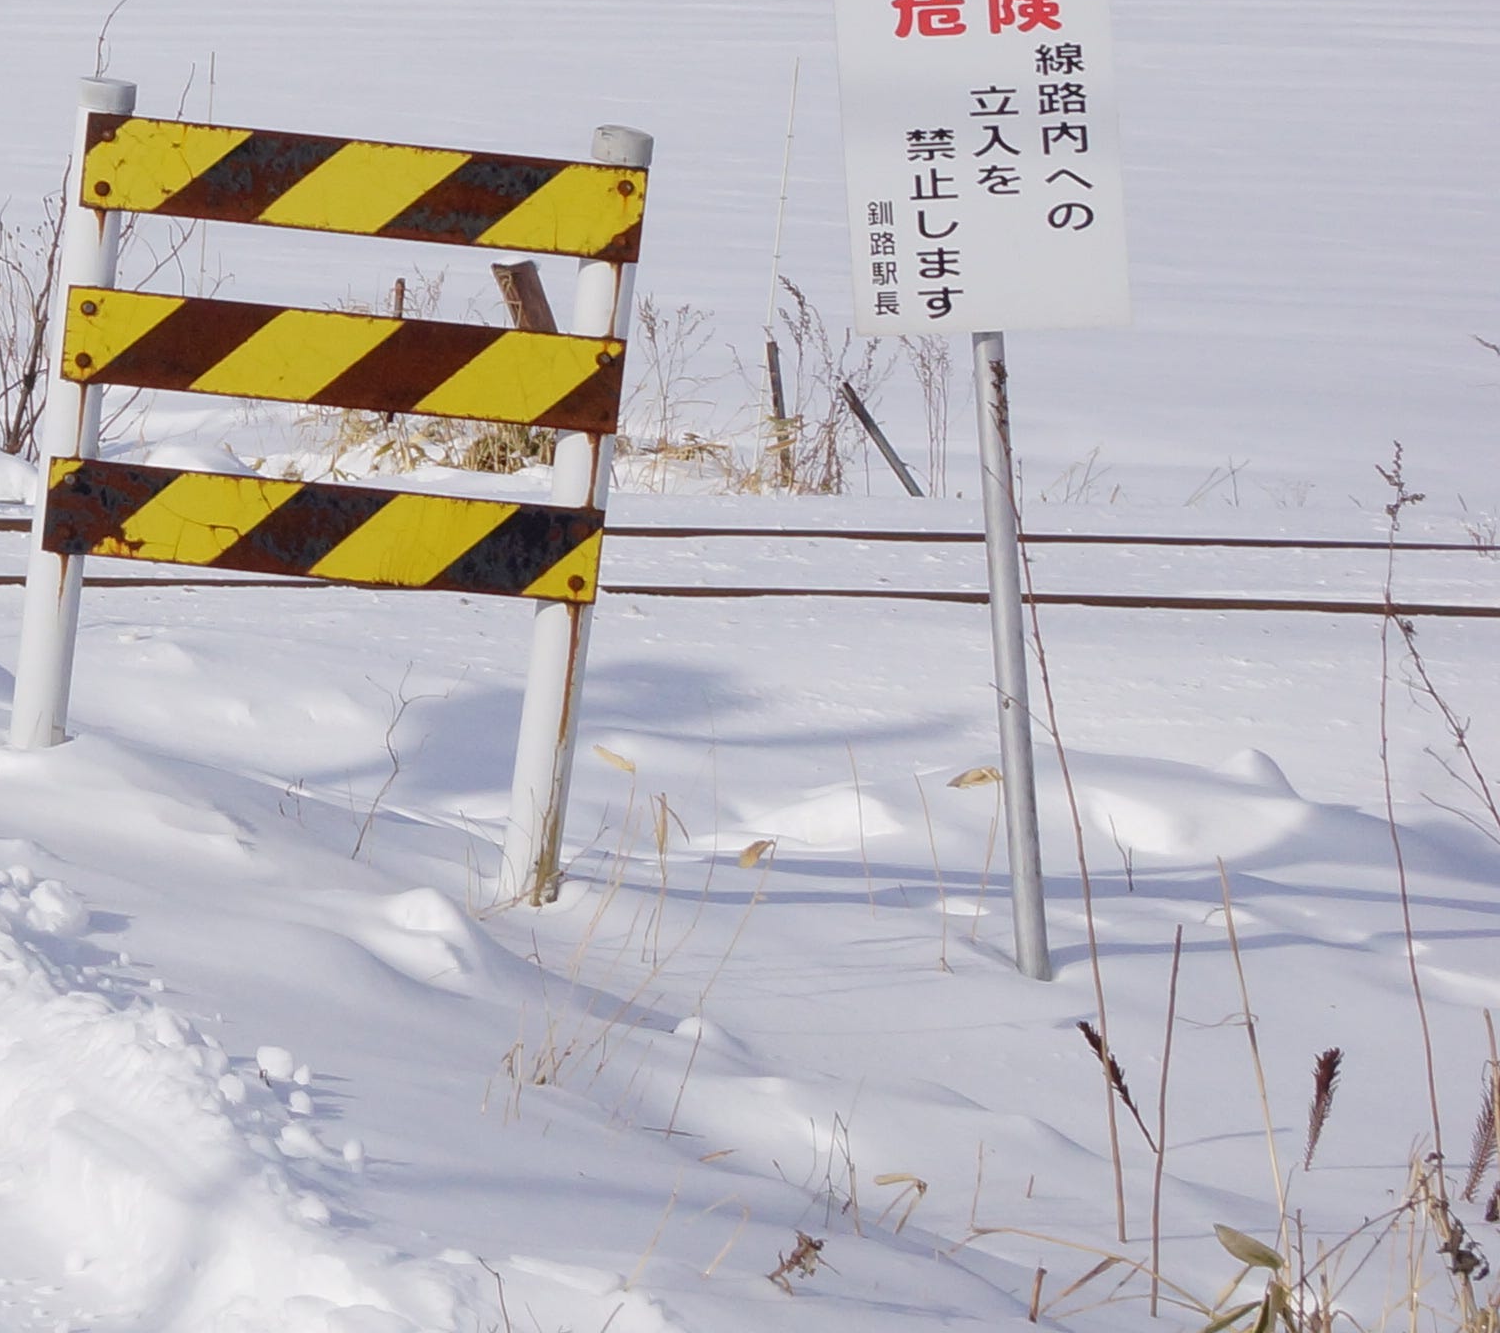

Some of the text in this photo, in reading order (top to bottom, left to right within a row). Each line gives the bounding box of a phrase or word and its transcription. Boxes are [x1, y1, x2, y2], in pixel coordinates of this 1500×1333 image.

[969, 86, 1022, 195] 立入を
[1035, 42, 1094, 231] 線路内への
[867, 201, 900, 316] 釧路駅長
[905, 128, 963, 319] 禁止します
